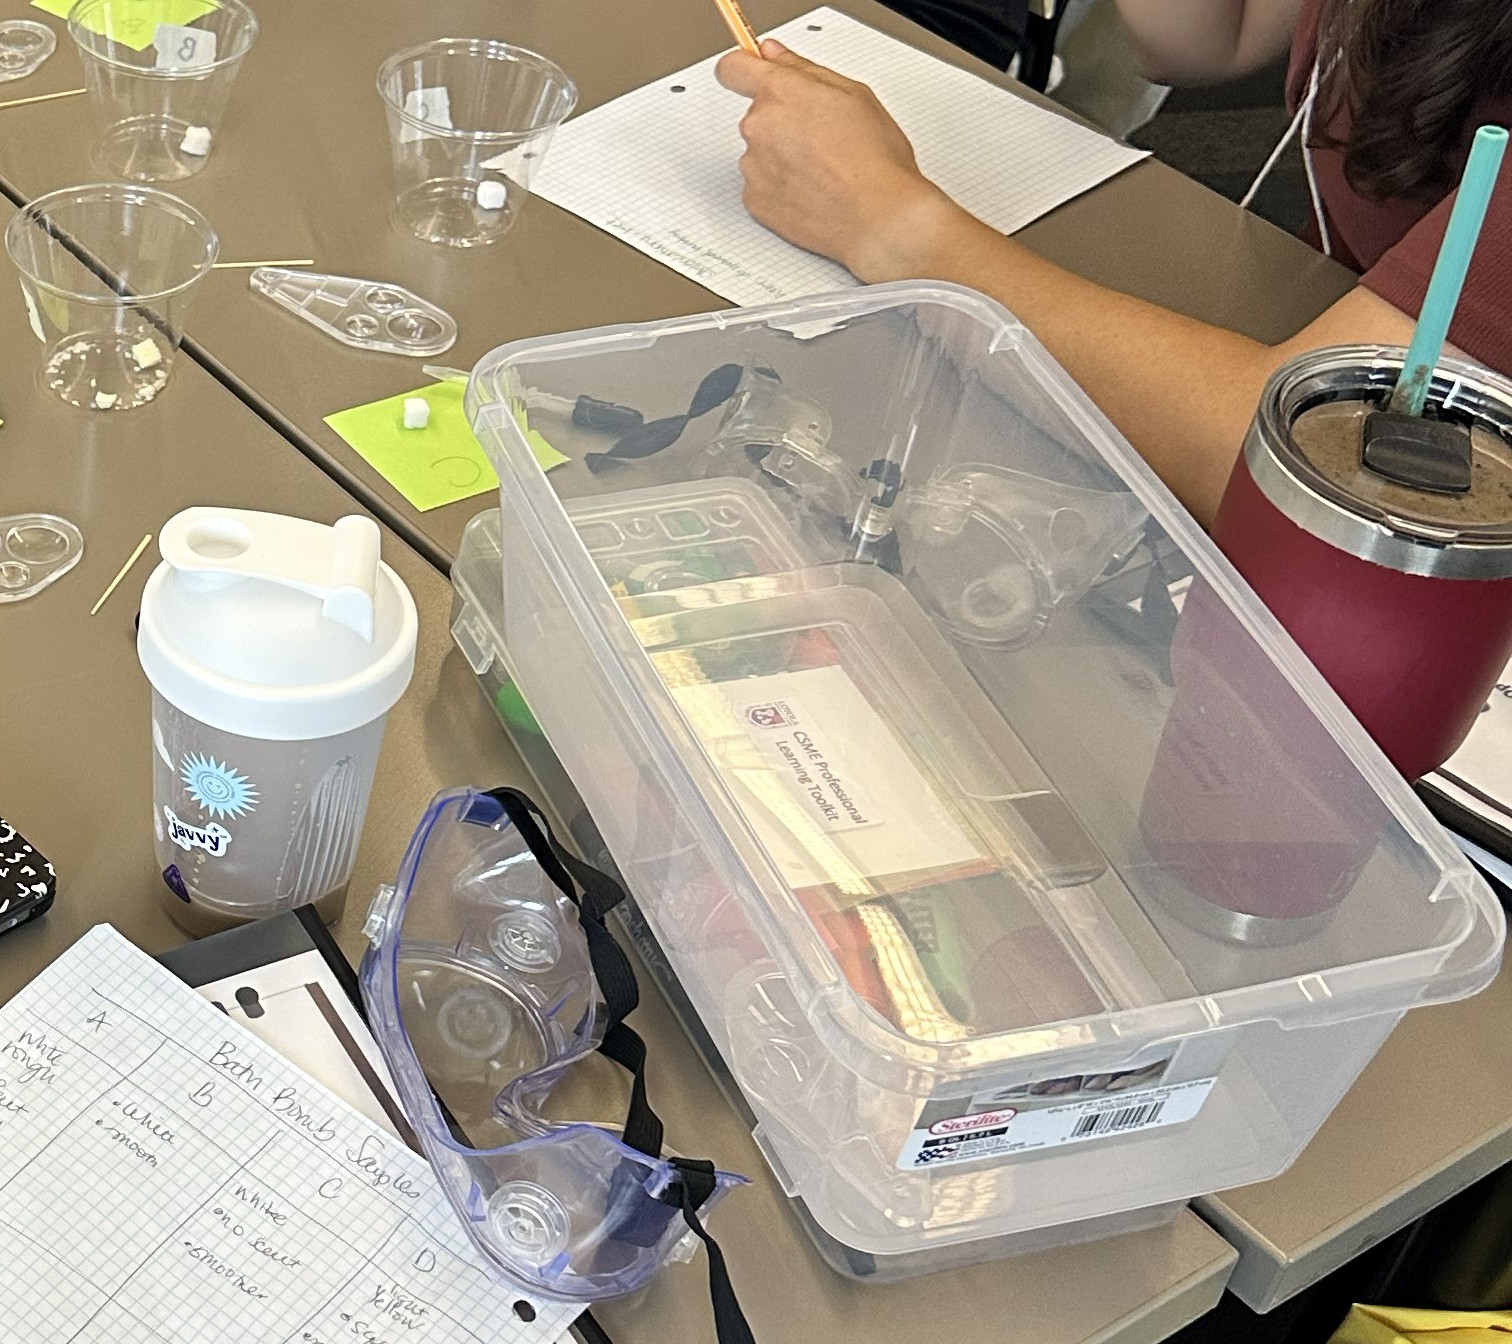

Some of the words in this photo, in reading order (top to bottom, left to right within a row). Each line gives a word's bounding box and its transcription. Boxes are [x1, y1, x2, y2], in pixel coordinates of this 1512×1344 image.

[775, 740, 813, 785] Learning
[808, 784, 839, 822] Toolkit
[793, 730, 824, 761] CSME
[814, 761, 869, 824] Professional
[170, 816, 220, 852] javvy
[86, 1010, 114, 1034] A
[188, 1081, 216, 1108] B
[208, 1040, 263, 1091] Bath
[273, 1087, 336, 1142] Bomb
[937, 1113, 1002, 1133] Sterilite
[318, 1177, 343, 1199] C
[220, 1213, 245, 1237] no
[412, 1247, 437, 1273] D
